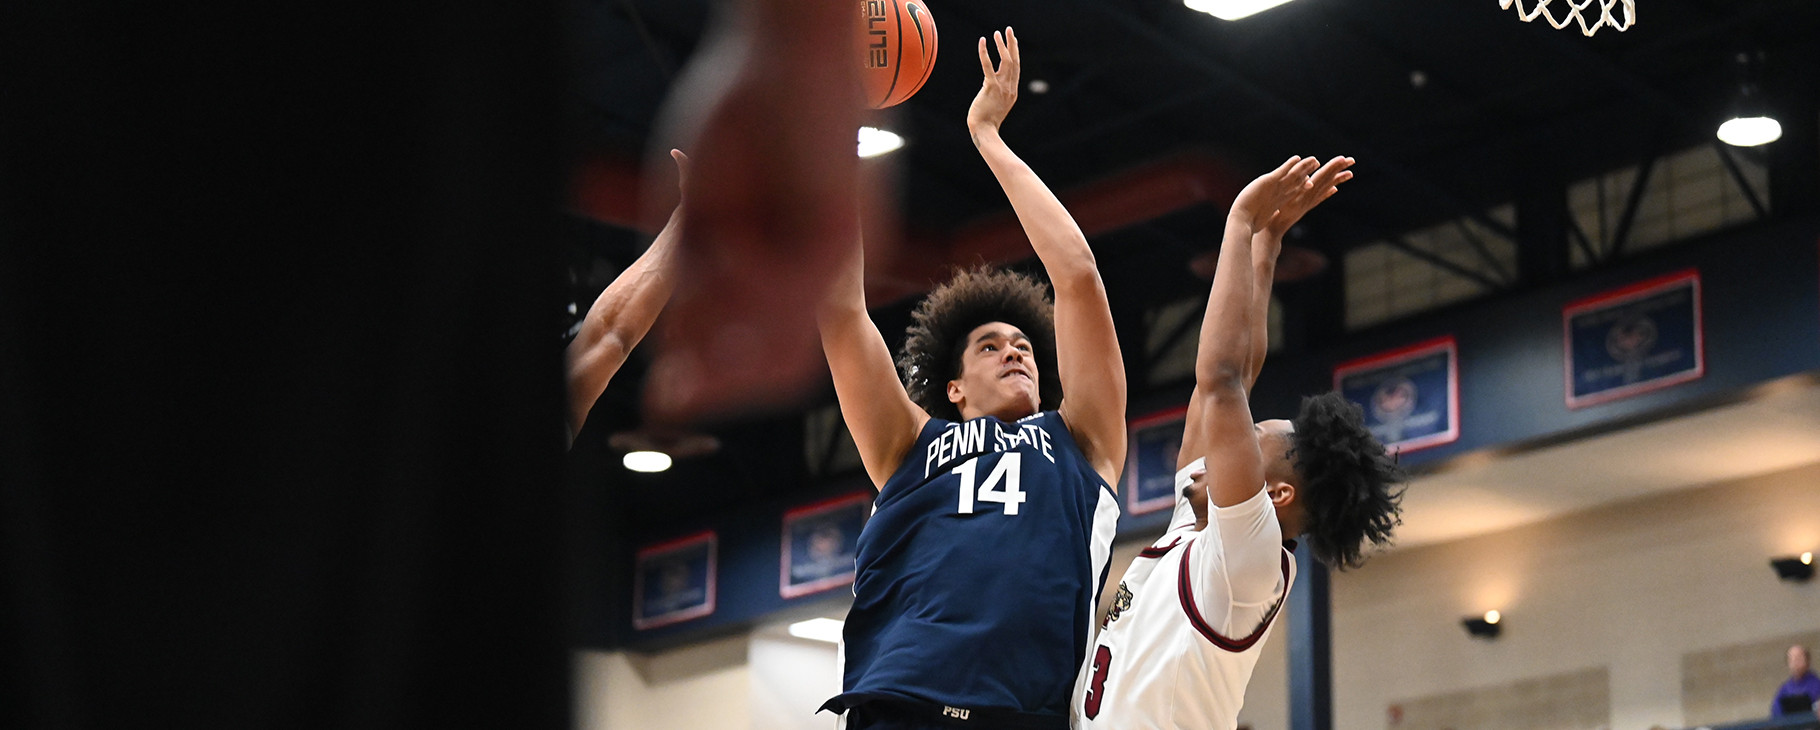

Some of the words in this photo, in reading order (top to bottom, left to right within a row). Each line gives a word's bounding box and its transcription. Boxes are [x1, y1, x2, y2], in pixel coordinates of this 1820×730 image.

[868, 0, 888, 68] ELITE
[924, 418, 986, 480] PENN
[994, 422, 1055, 464] STATE
[951, 452, 1026, 515] 14
[943, 706, 970, 720] PSU
[1084, 644, 1112, 721] 3
